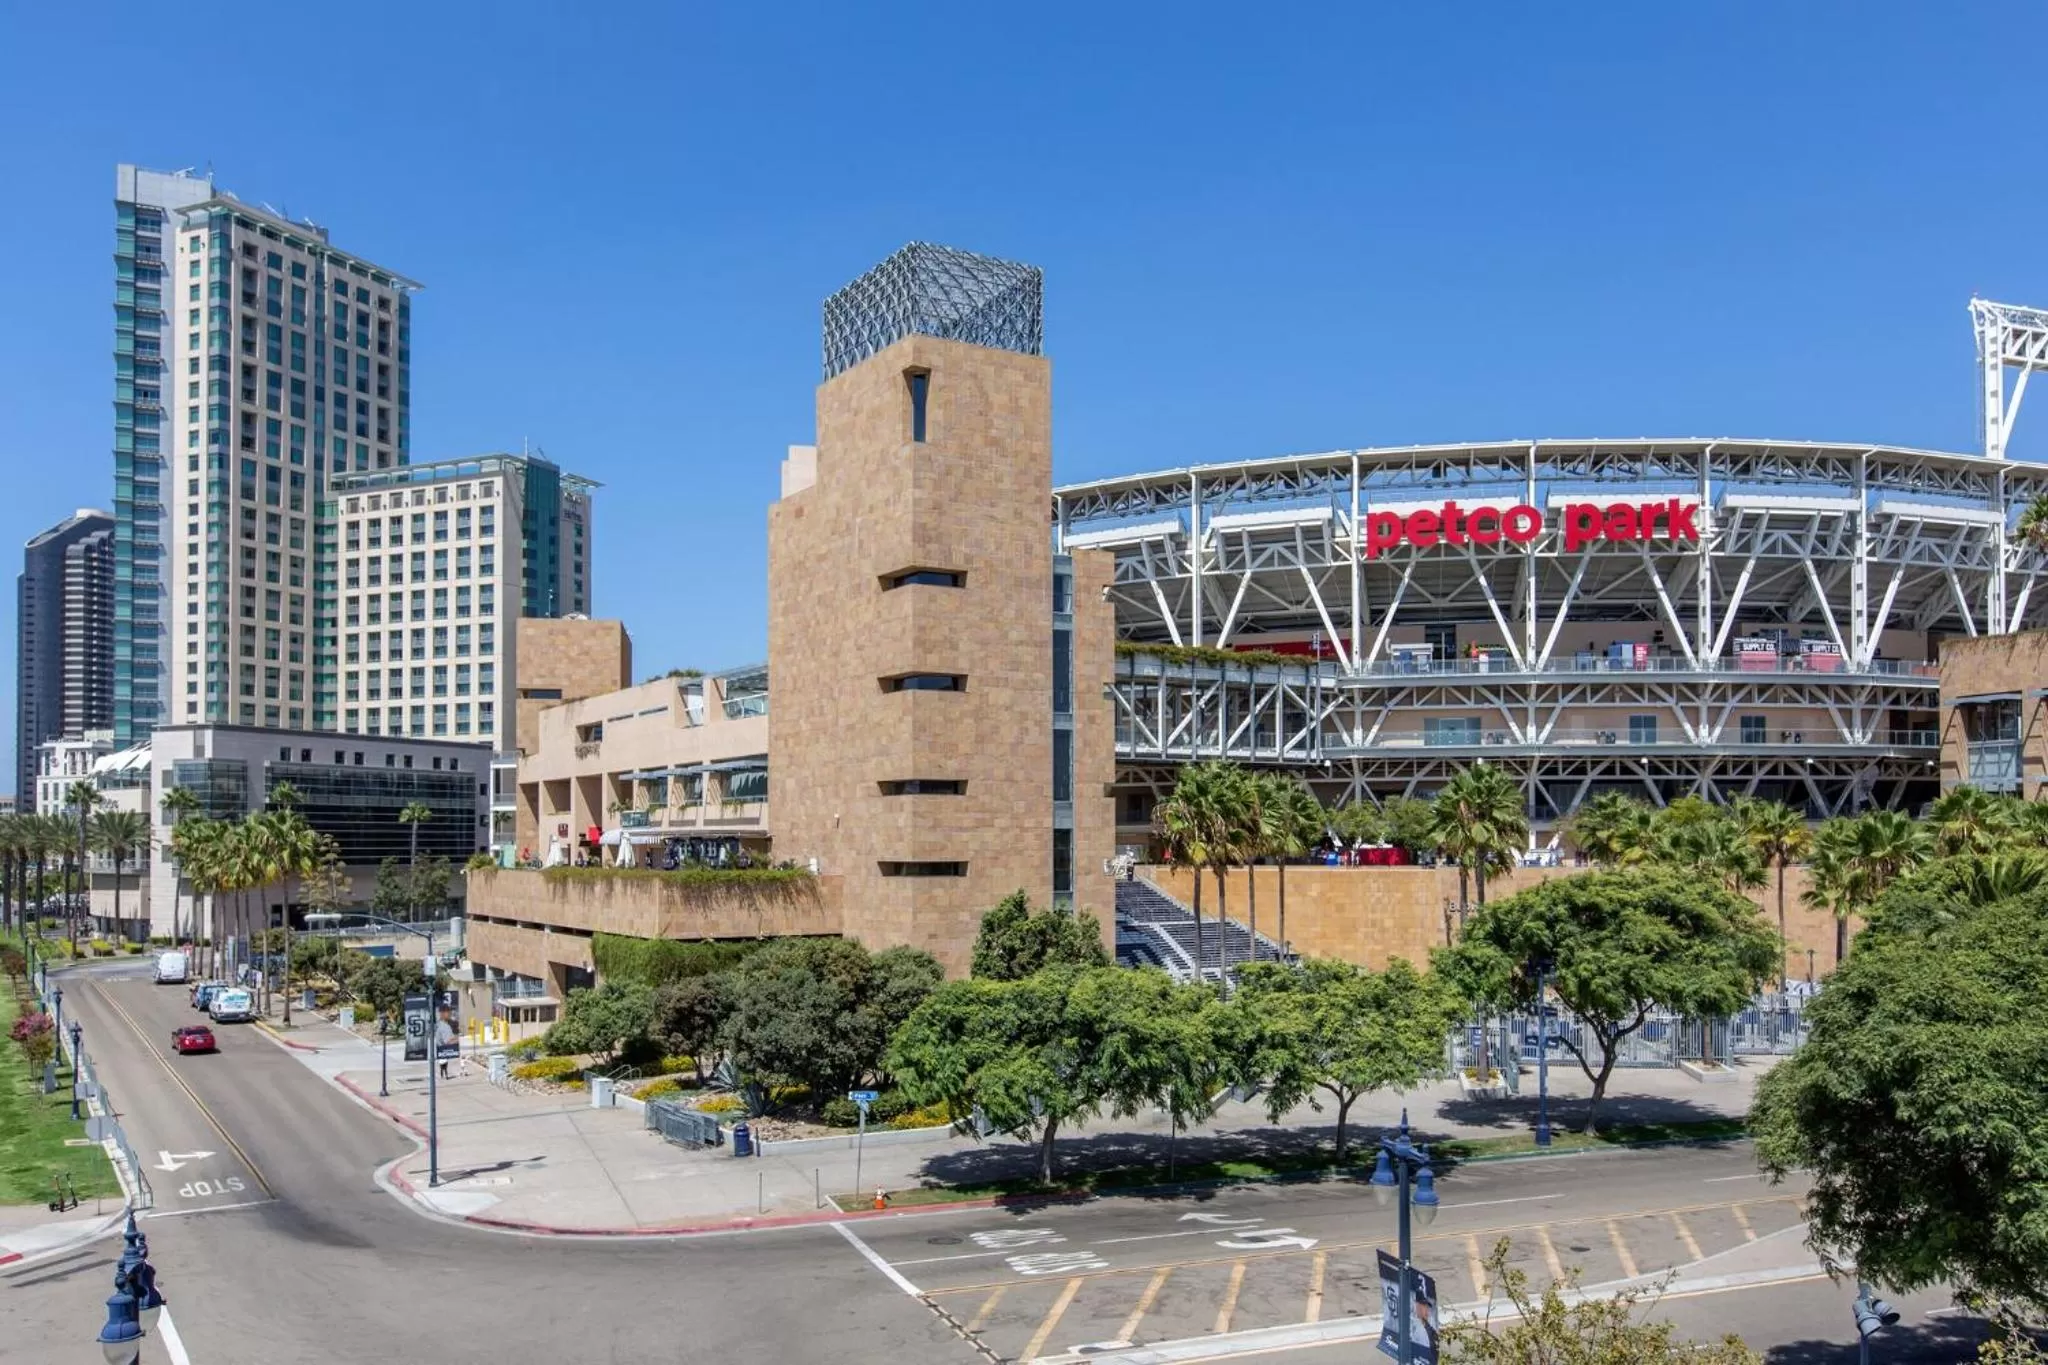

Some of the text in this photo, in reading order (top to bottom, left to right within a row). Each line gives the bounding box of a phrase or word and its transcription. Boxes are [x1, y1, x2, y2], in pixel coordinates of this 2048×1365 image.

[1366, 499, 1699, 559] petco park
[179, 1176, 245, 1198] STOP
